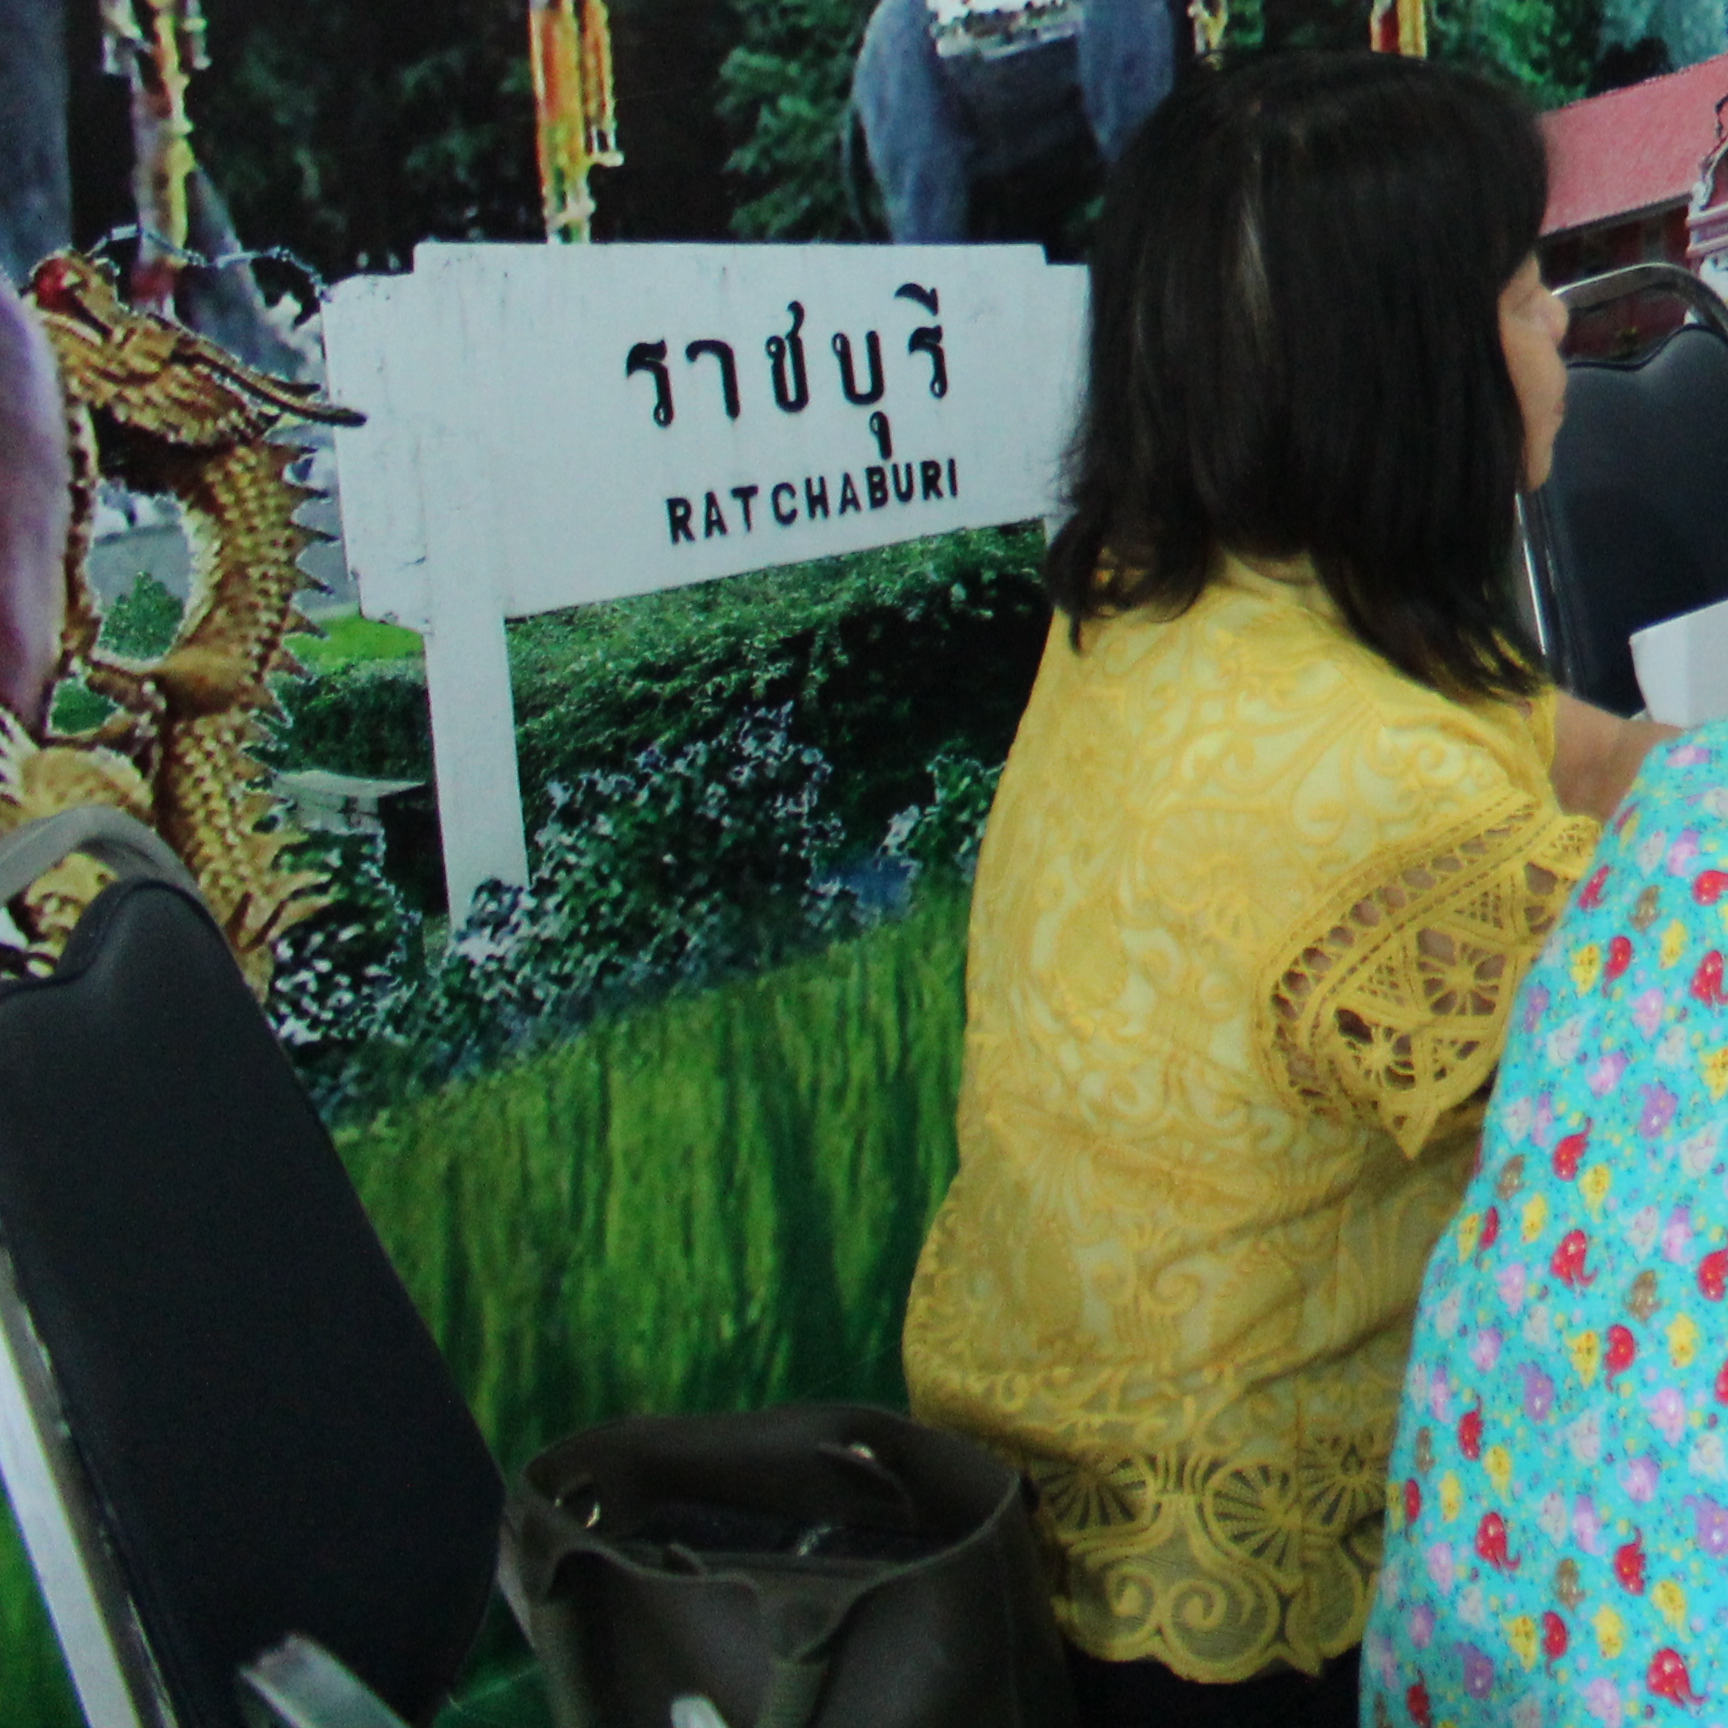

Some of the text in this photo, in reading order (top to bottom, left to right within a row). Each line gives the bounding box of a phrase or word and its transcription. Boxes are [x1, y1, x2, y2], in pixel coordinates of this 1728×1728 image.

[625, 282, 950, 459] ราชบุรี
[665, 458, 959, 545] RATCHABURI
